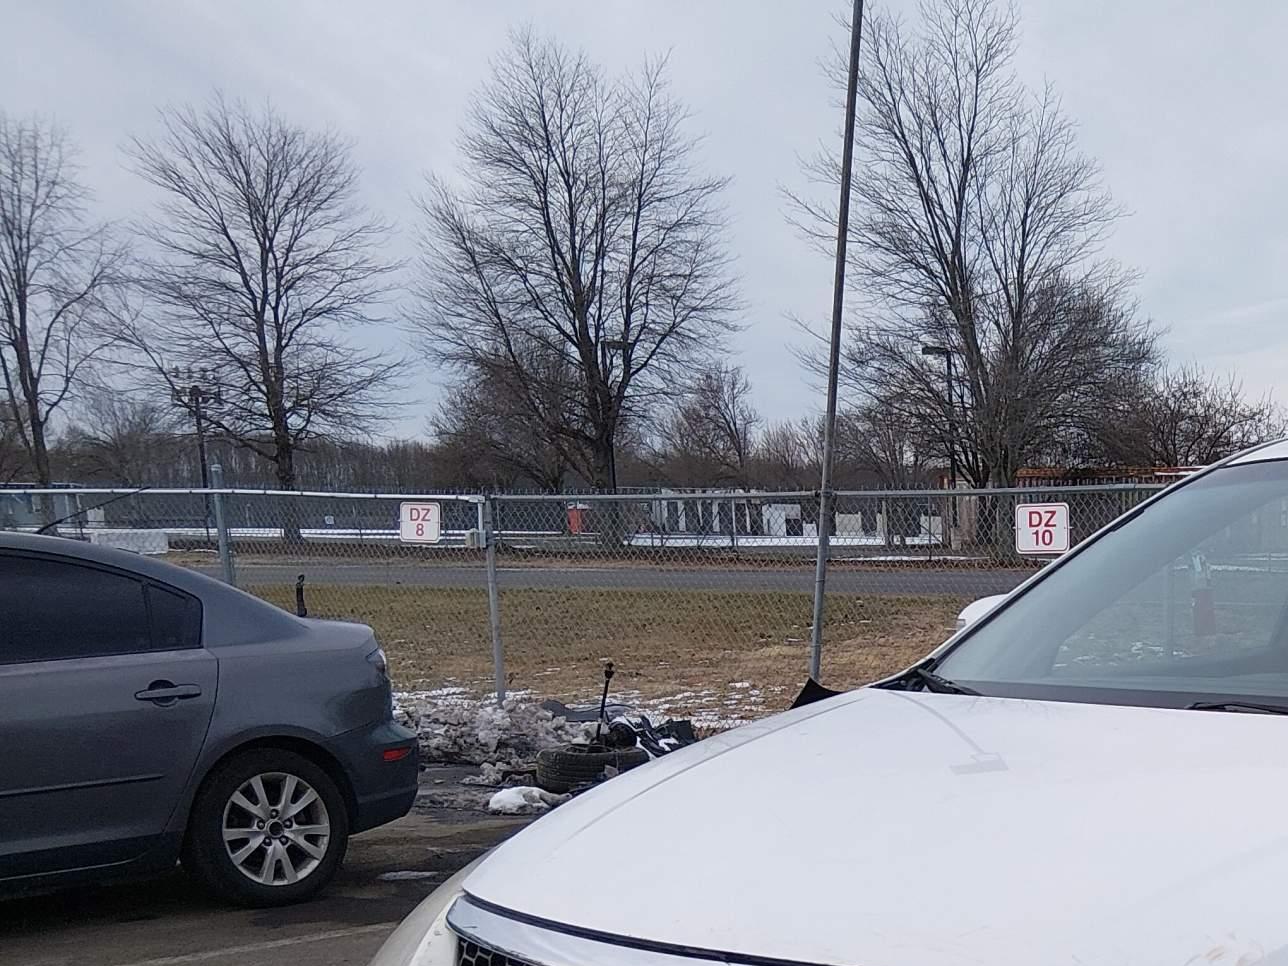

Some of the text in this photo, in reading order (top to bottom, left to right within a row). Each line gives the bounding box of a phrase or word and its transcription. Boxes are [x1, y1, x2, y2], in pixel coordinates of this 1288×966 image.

[410, 508, 431, 521] DZ
[1028, 511, 1057, 528] DZ
[416, 523, 424, 536] 8
[1031, 529, 1053, 546] 10
